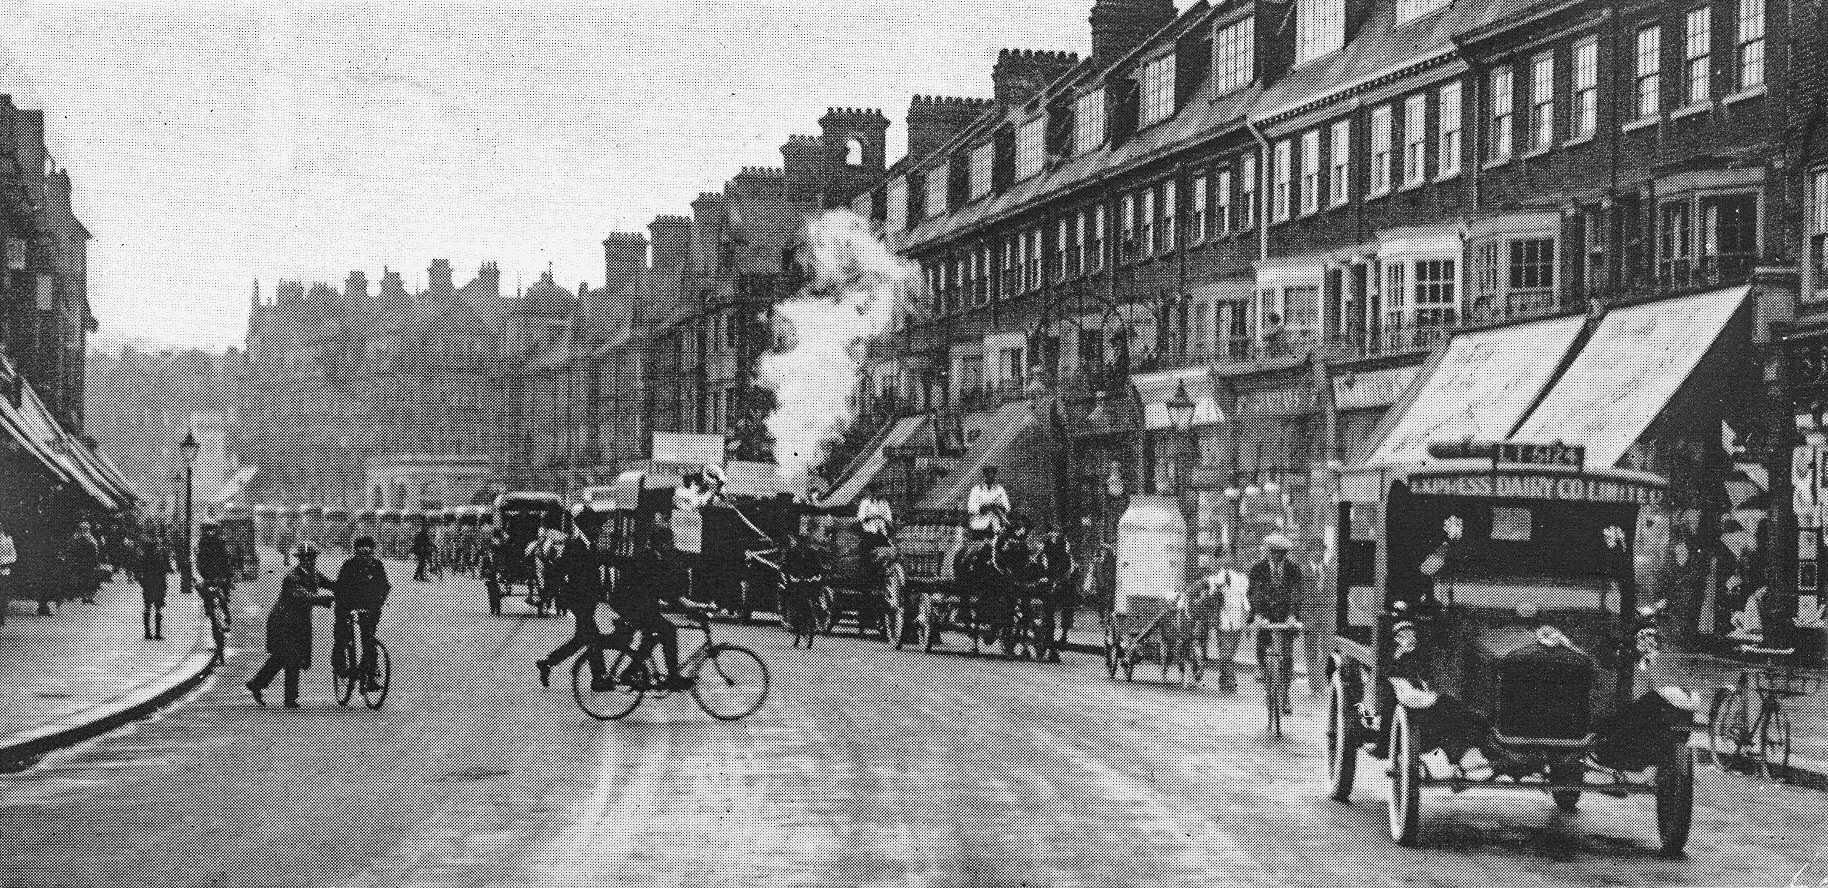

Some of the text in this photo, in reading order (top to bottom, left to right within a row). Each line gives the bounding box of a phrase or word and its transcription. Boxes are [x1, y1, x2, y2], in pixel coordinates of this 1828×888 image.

[1410, 477, 1492, 496] EXPRESS
[1496, 476, 1555, 498] DAIRY
[1587, 481, 1663, 506] LIMITED
